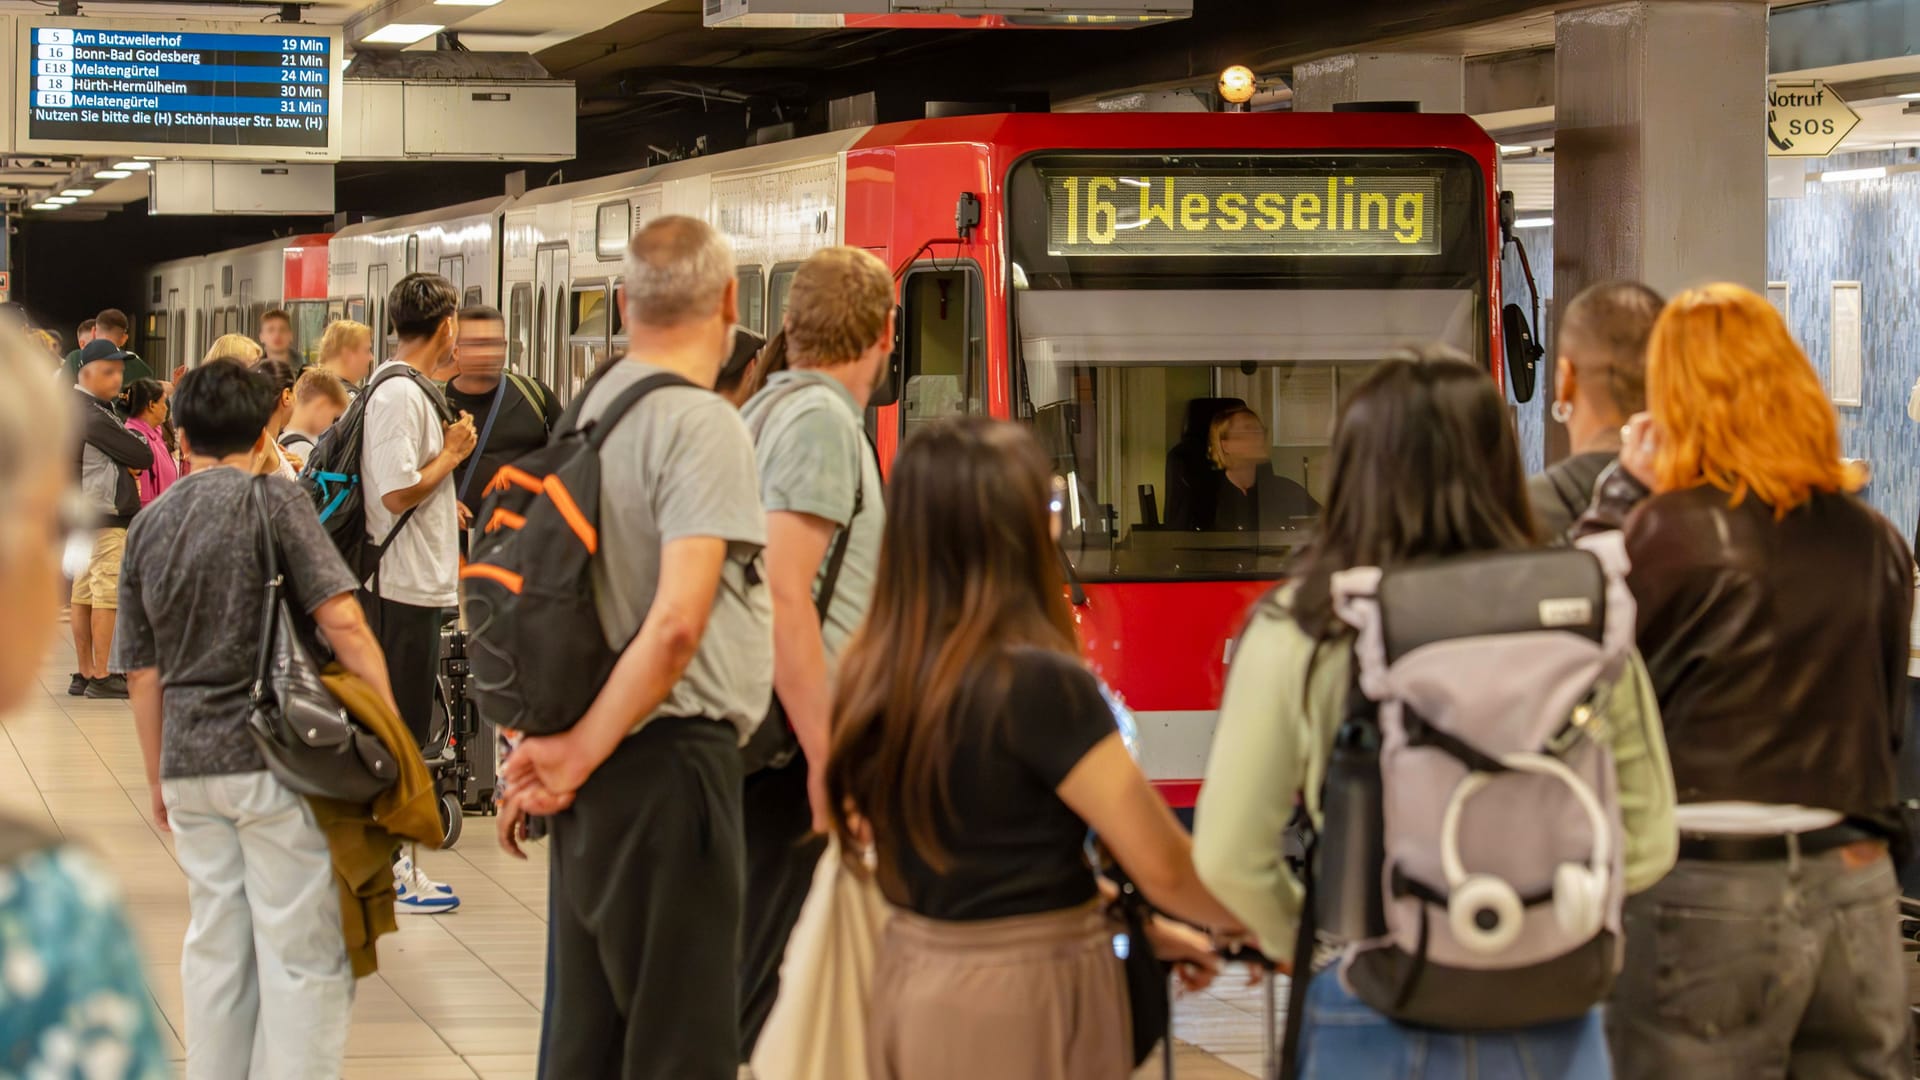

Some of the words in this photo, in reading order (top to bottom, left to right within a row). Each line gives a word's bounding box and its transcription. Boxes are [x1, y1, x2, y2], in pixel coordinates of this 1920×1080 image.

[52, 31, 60, 42] 5
[74, 32, 96, 44] Am
[98, 32, 182, 47] Butzweilerhof
[282, 38, 297, 51] 19
[300, 39, 324, 52] Min
[49, 47, 63, 58] 16
[75, 47, 133, 61] Bonn-Bad
[135, 49, 201, 66] Godesberg
[281, 54, 297, 67] 21
[299, 55, 323, 68] Min
[45, 63, 67, 74] E18
[74, 63, 160, 79] Melatengürtel
[281, 69, 297, 82] 24
[299, 70, 323, 83] Min
[48, 78, 63, 89] 18
[74, 78, 188, 95] Hürth-Hermülheim
[280, 85, 296, 98] 30
[299, 86, 322, 99] Min
[1768, 90, 1824, 108] Notruf
[44, 93, 67, 105] E16
[74, 94, 159, 110] Melatengürtel
[280, 101, 296, 113] 31
[298, 101, 322, 114] Min
[35, 108, 78, 122] Nutzen
[80, 110, 99, 123] Sie
[101, 111, 130, 124] bitte
[132, 111, 151, 124] die
[153, 112, 172, 127] (H)
[174, 113, 252, 128] Schönhauser
[253, 115, 273, 128] Str.
[275, 115, 302, 129] bzw.
[304, 117, 323, 131] (H)
[1789, 118, 1835, 135] SOS
[1063, 176, 1117, 245] 16
[1138, 176, 1425, 244] Wesseling
